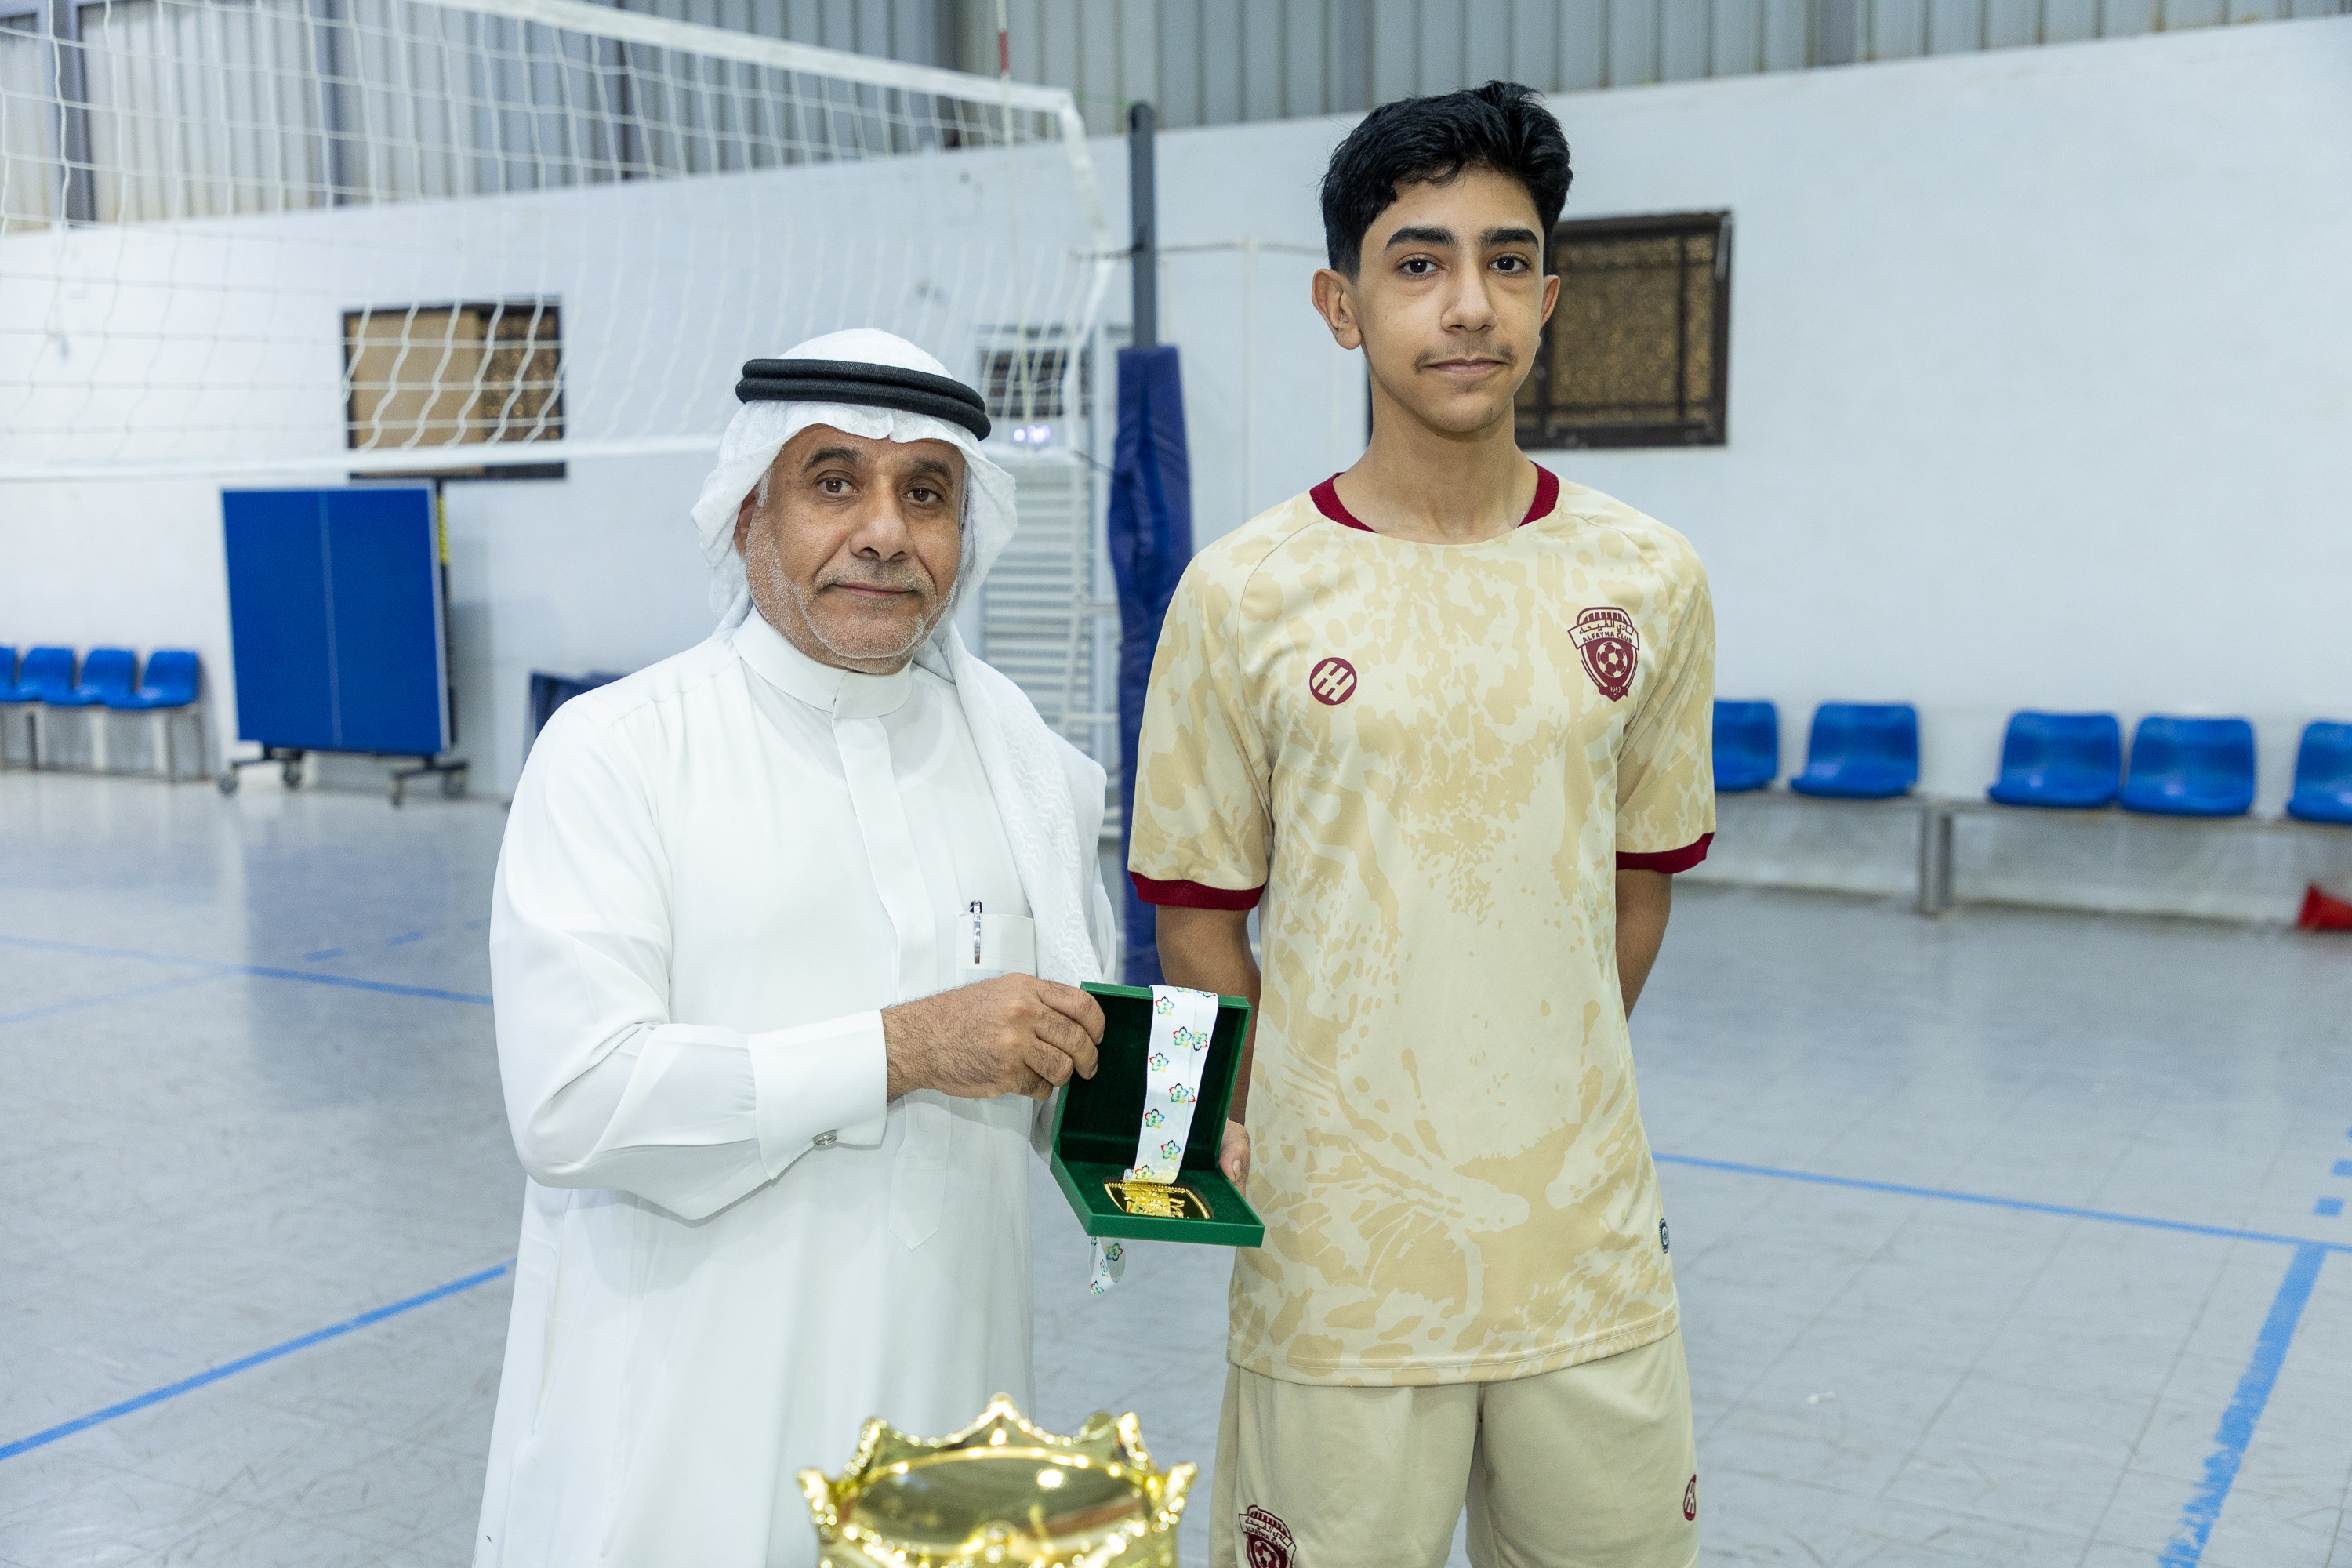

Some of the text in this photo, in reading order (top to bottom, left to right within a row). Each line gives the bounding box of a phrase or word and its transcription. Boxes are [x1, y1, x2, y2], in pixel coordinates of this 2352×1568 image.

[1579, 619, 1634, 636] نادي الفيحاء
[1582, 631, 1632, 644] ALFAYHA CLUB
